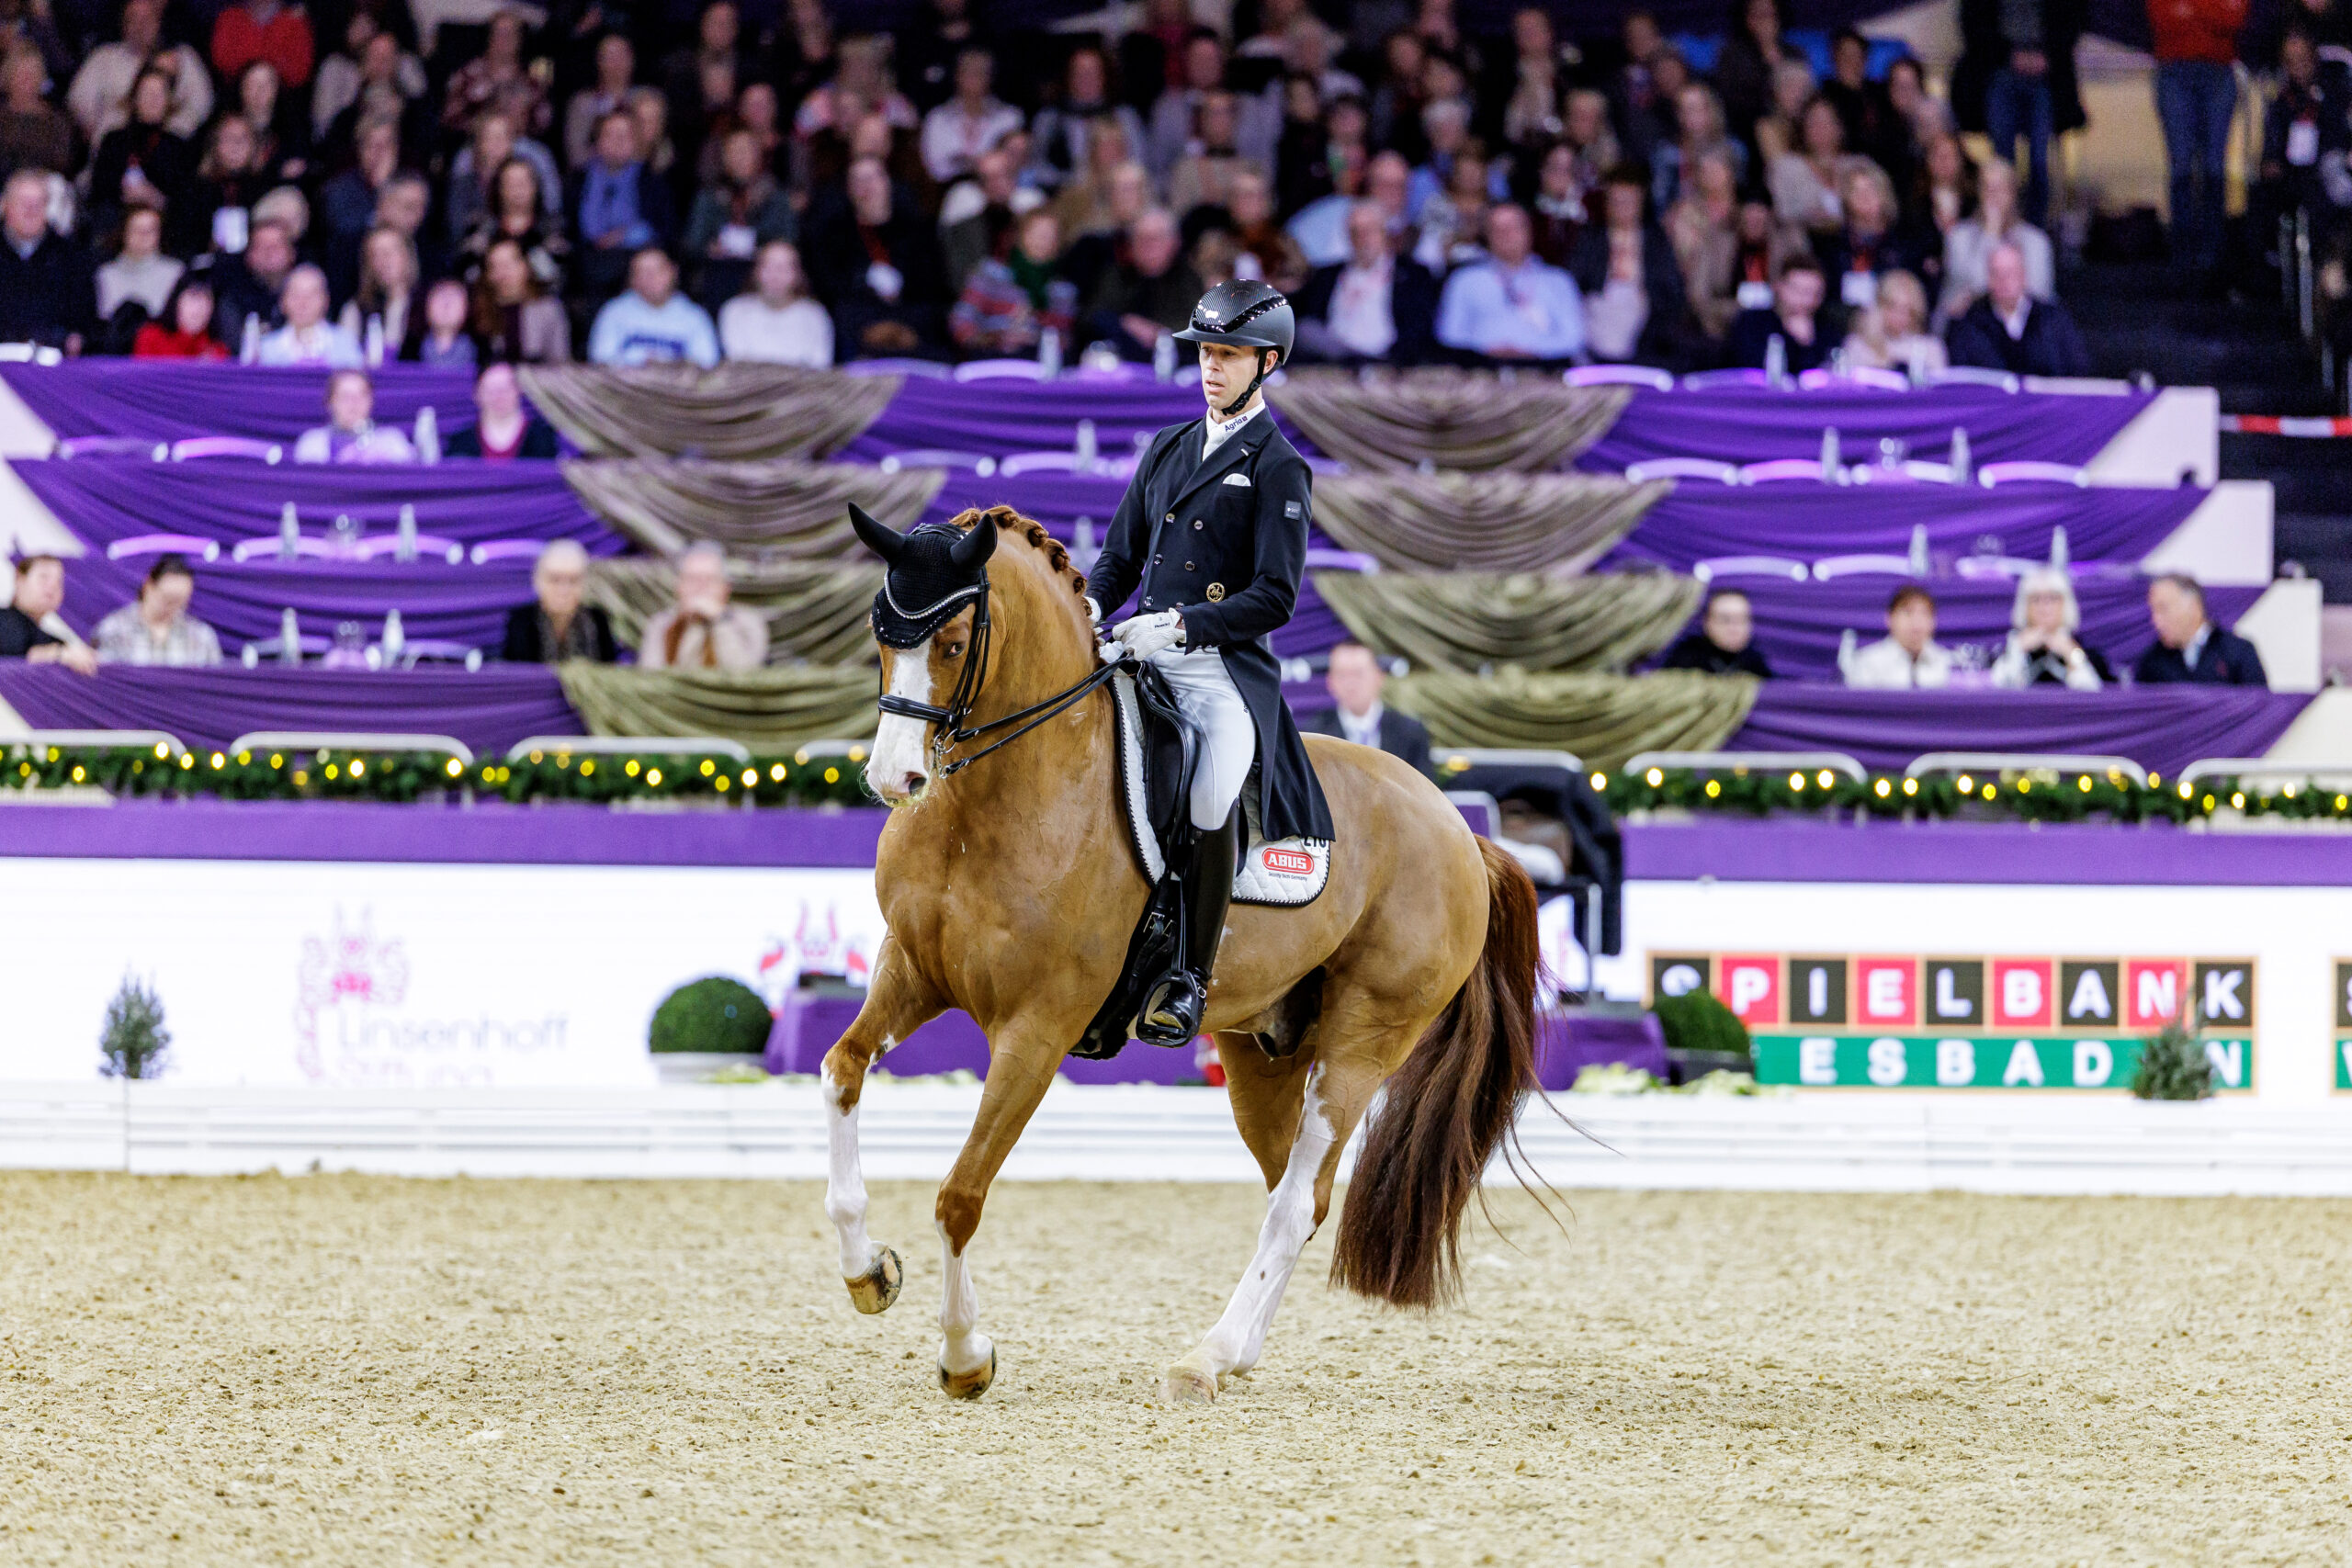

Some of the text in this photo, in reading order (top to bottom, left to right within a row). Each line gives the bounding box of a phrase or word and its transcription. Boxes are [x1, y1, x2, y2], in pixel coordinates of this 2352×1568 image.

[1225, 418, 1242, 432] Agria
[1268, 852, 1307, 870] ABUS
[1661, 964, 2245, 1018] SPIELBANK
[1799, 1037, 2243, 1088] ESBADN
